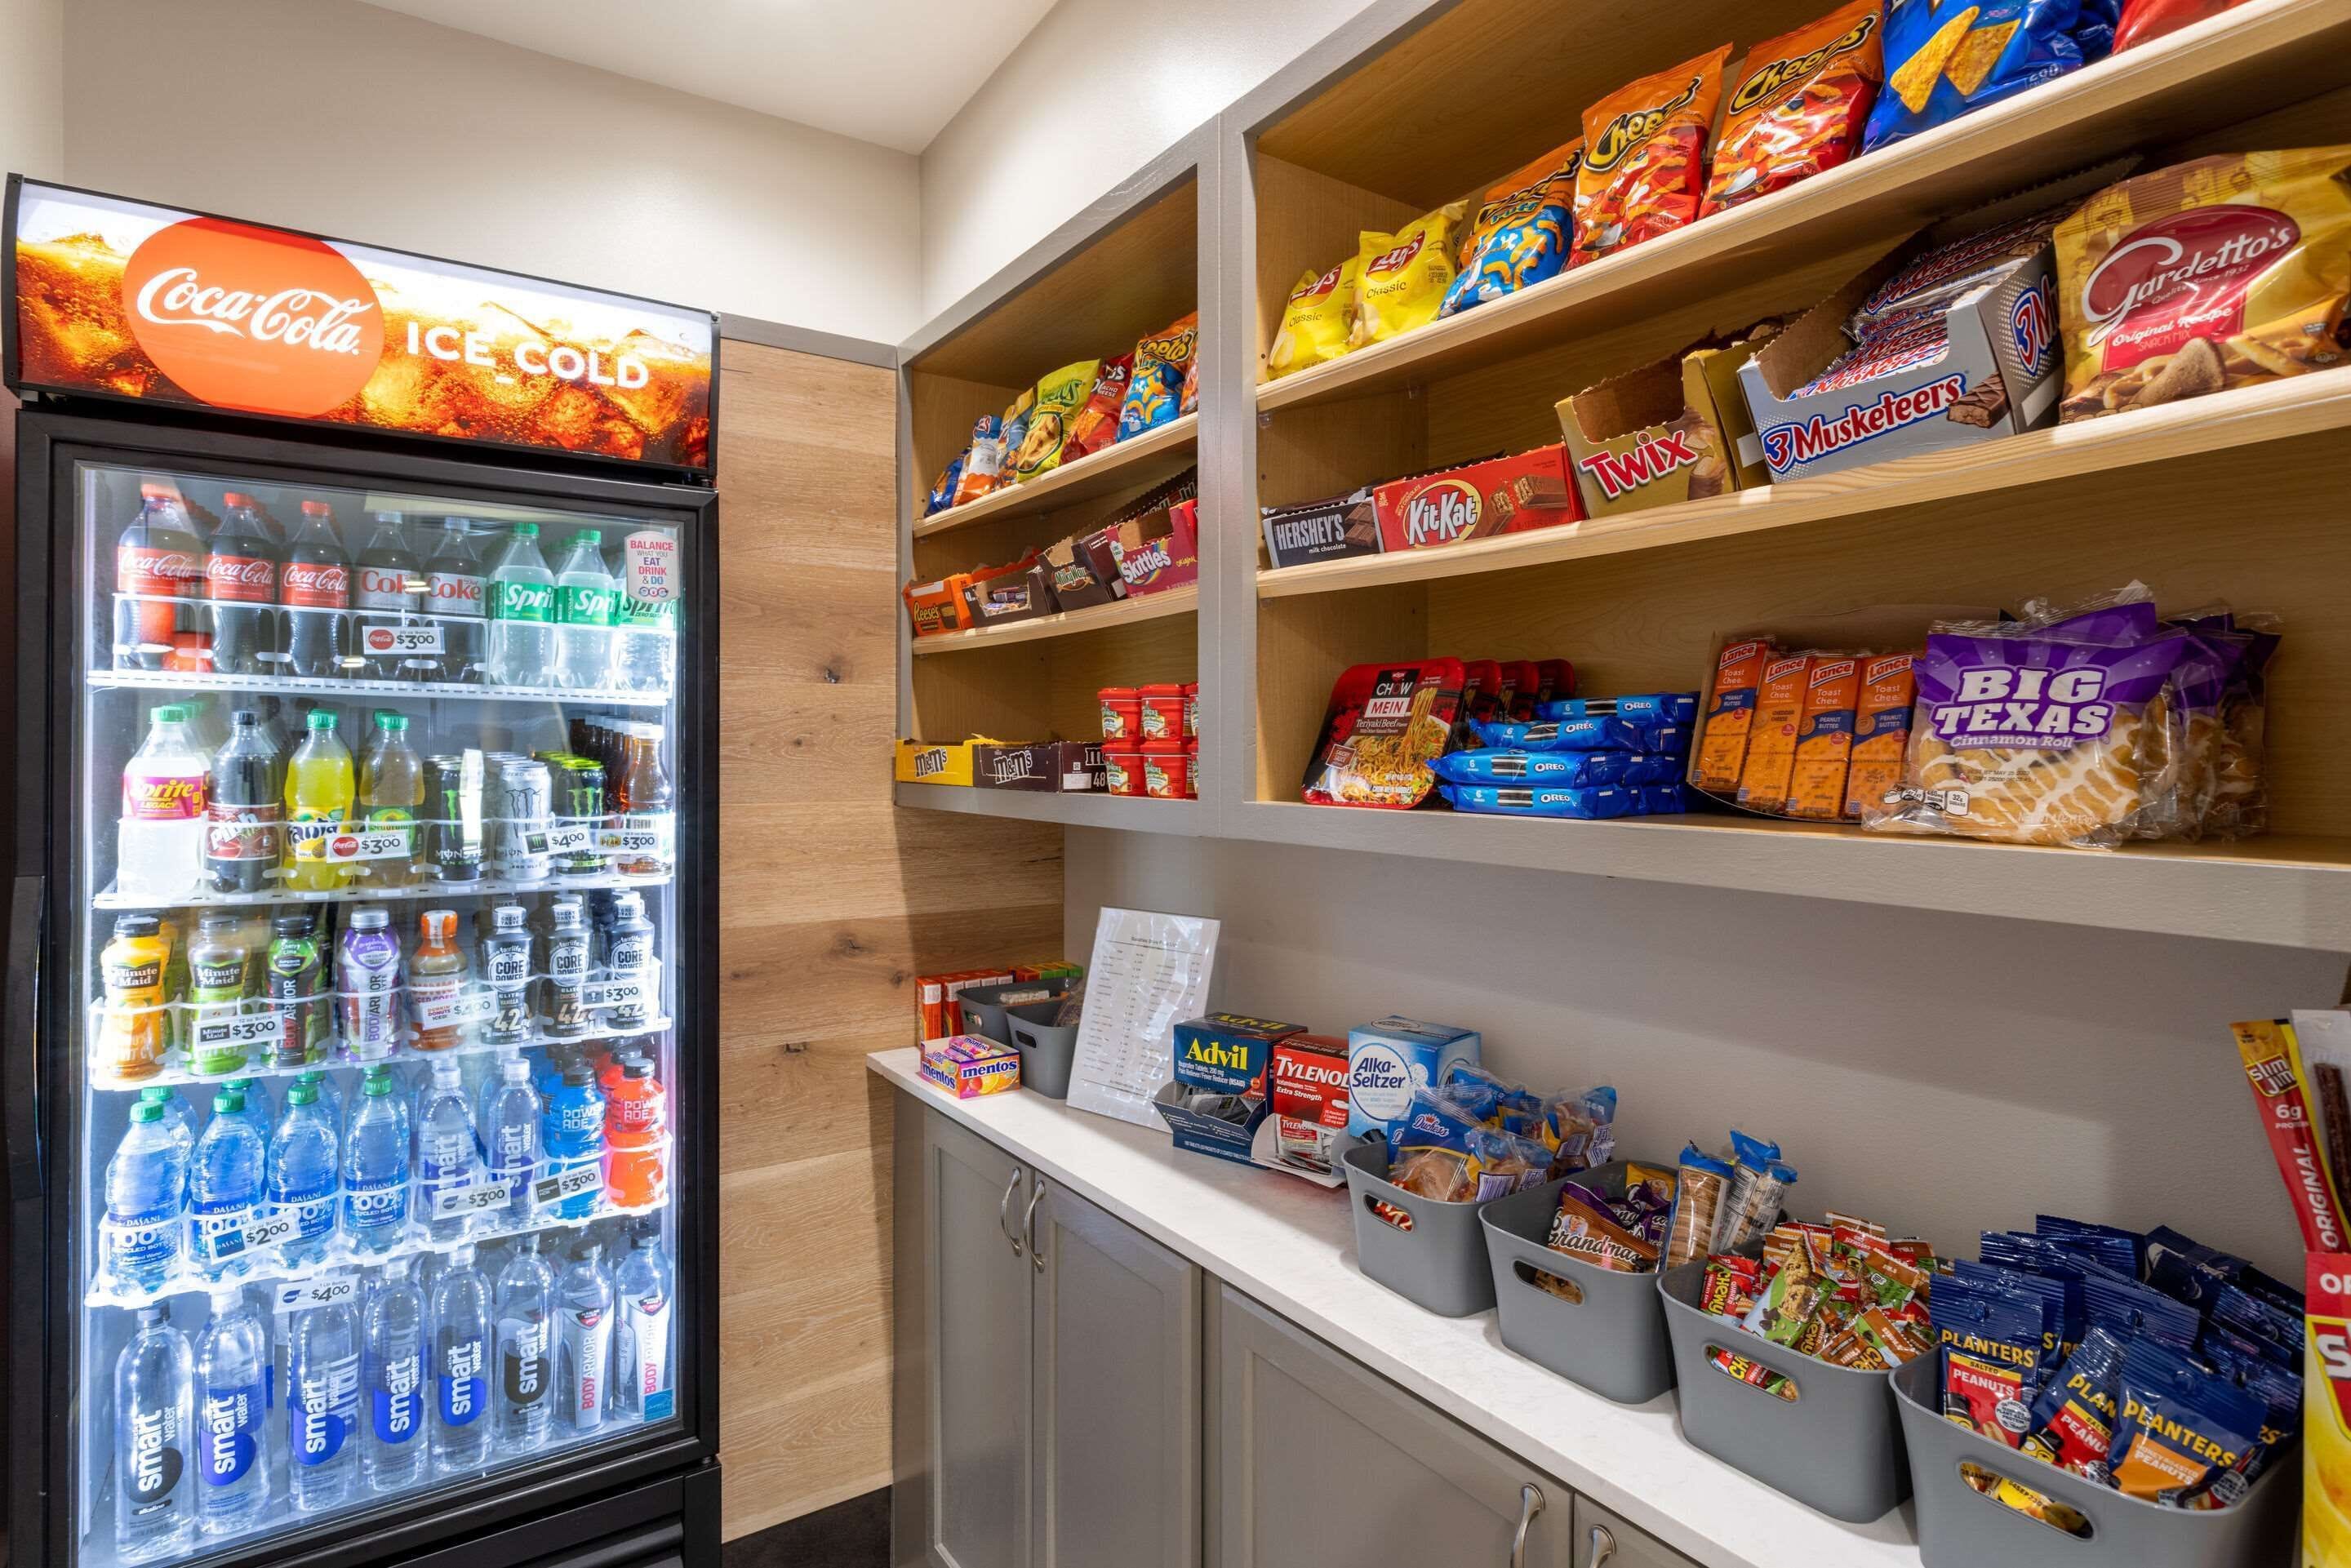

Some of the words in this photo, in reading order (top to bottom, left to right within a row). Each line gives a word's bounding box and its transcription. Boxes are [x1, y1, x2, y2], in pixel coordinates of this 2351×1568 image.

[1366, 279, 1407, 299] Classic
[2083, 227, 2291, 347] Gardetto's
[136, 268, 376, 356] Coca-Cola
[2113, 321, 2175, 347] Original
[407, 322, 496, 367] ICE
[514, 341, 650, 390] COLD
[1766, 431, 1789, 469] 3
[1795, 375, 1962, 461] Musketeers
[1580, 429, 1697, 500] Twix
[1407, 491, 1478, 545] KitKat
[1275, 513, 1346, 550] HERSHEY'S
[630, 540, 674, 551] BALANCE
[206, 557, 274, 584] Coca-Cola
[638, 566, 666, 575] DRINK
[643, 557, 660, 566] EAT
[1121, 550, 1171, 584] Skittles
[284, 566, 347, 591] Coca-Cola
[914, 602, 940, 623] Reese's
[1721, 645, 1755, 665] Lance
[1723, 669, 1744, 677] Toast
[1767, 657, 1806, 680] Lance
[1812, 663, 1854, 686] Lance
[1868, 656, 1911, 681] Lance
[1771, 683, 1793, 691] Toast
[1817, 689, 1842, 698] Toast
[1874, 685, 1900, 694] Toast
[1959, 669, 2104, 704] BIG
[1371, 701, 1404, 714] MEIN
[1624, 702, 1651, 712] OREO
[1356, 718, 1383, 731] Teriyaki
[1382, 718, 1398, 728] Beef
[1934, 704, 2111, 735] TEXAS
[1950, 735, 2037, 748] Cinnamon
[2040, 735, 2073, 748] Roll
[1535, 762, 1565, 773] OREO
[1093, 772, 1105, 787] 48
[1540, 793, 1570, 803] OREO
[496, 960, 524, 974] CORE
[557, 953, 583, 969] CORE
[618, 949, 643, 964] CORE
[202, 976, 234, 985] Maid
[495, 1008, 521, 1032] 42
[1184, 1038, 1248, 1071] Advil
[1356, 1057, 1396, 1073] Alka-
[922, 1063, 956, 1090] mentos
[962, 1060, 1017, 1078] mentos
[1276, 1055, 1350, 1088] TYLENOL
[1353, 1073, 1406, 1090] Seltzer
[1276, 1086, 1292, 1098] Extra
[1293, 1089, 1322, 1102] Strength
[562, 1119, 589, 1129] ADE
[624, 1108, 650, 1120] ADE
[2276, 1104, 2302, 1121] 6g
[1412, 1115, 1449, 1137] Duchess
[2294, 1144, 2340, 1249] ORIGINAL
[1942, 1329, 2036, 1368] PLANTERS
[516, 1322, 538, 1402] smart
[1970, 1360, 1999, 1375] SALTED
[448, 1342, 471, 1415] smart
[1953, 1369, 2015, 1398] PEANUTS
[389, 1357, 411, 1433] smart
[304, 1379, 327, 1455] smart
[211, 1396, 236, 1475] smart
[2122, 1401, 2239, 1468] PLANTERS
[137, 1410, 162, 1492] smart
[2134, 1449, 2196, 1486] PEANUTS
